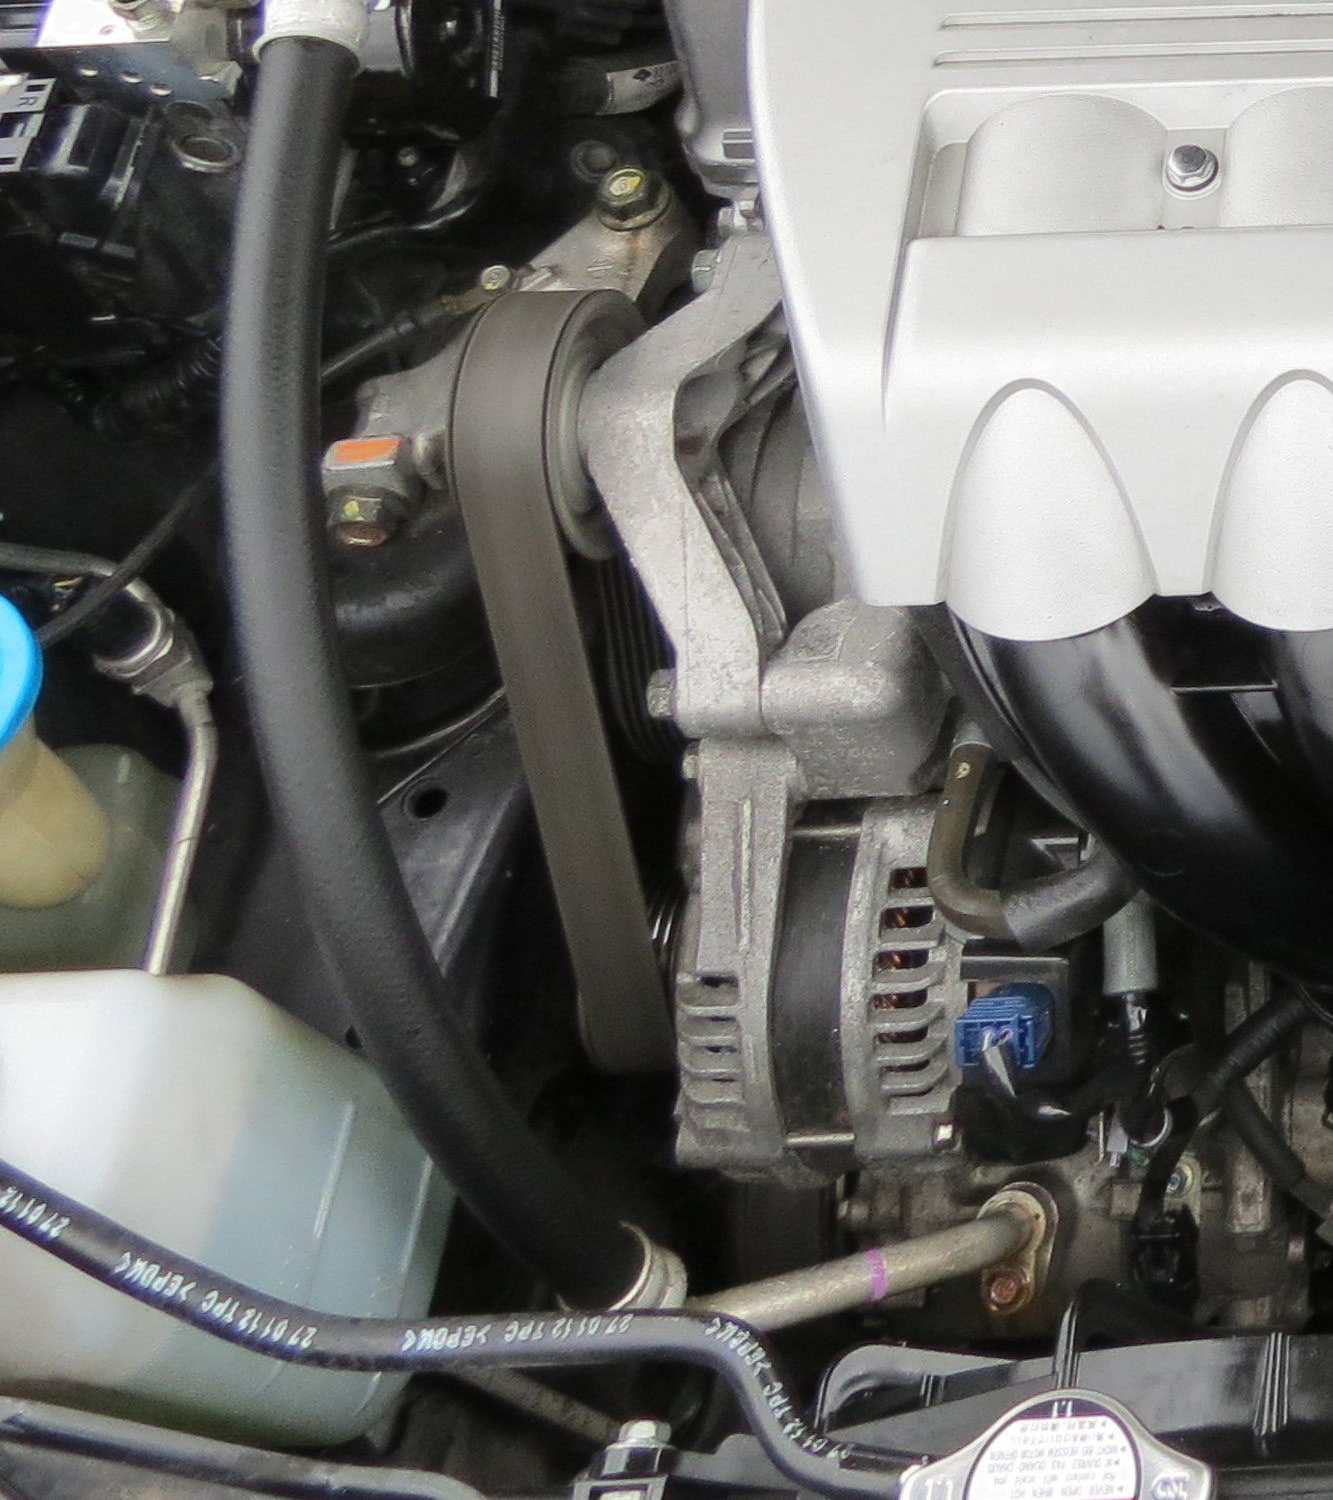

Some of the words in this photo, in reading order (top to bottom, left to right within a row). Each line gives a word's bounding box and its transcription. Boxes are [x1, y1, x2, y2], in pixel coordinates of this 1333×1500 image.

[16, 1198, 46, 1226] 01
[39, 1212, 71, 1240] 27
[200, 1289, 241, 1324] TPC
[237, 1308, 264, 1334] 12
[260, 1318, 289, 1342] 01
[503, 1320, 546, 1343] TPC
[551, 1317, 574, 1340] 12
[576, 1316, 602, 1338] 01
[605, 1313, 635, 1335] 27
[287, 1326, 318, 1350] 27
